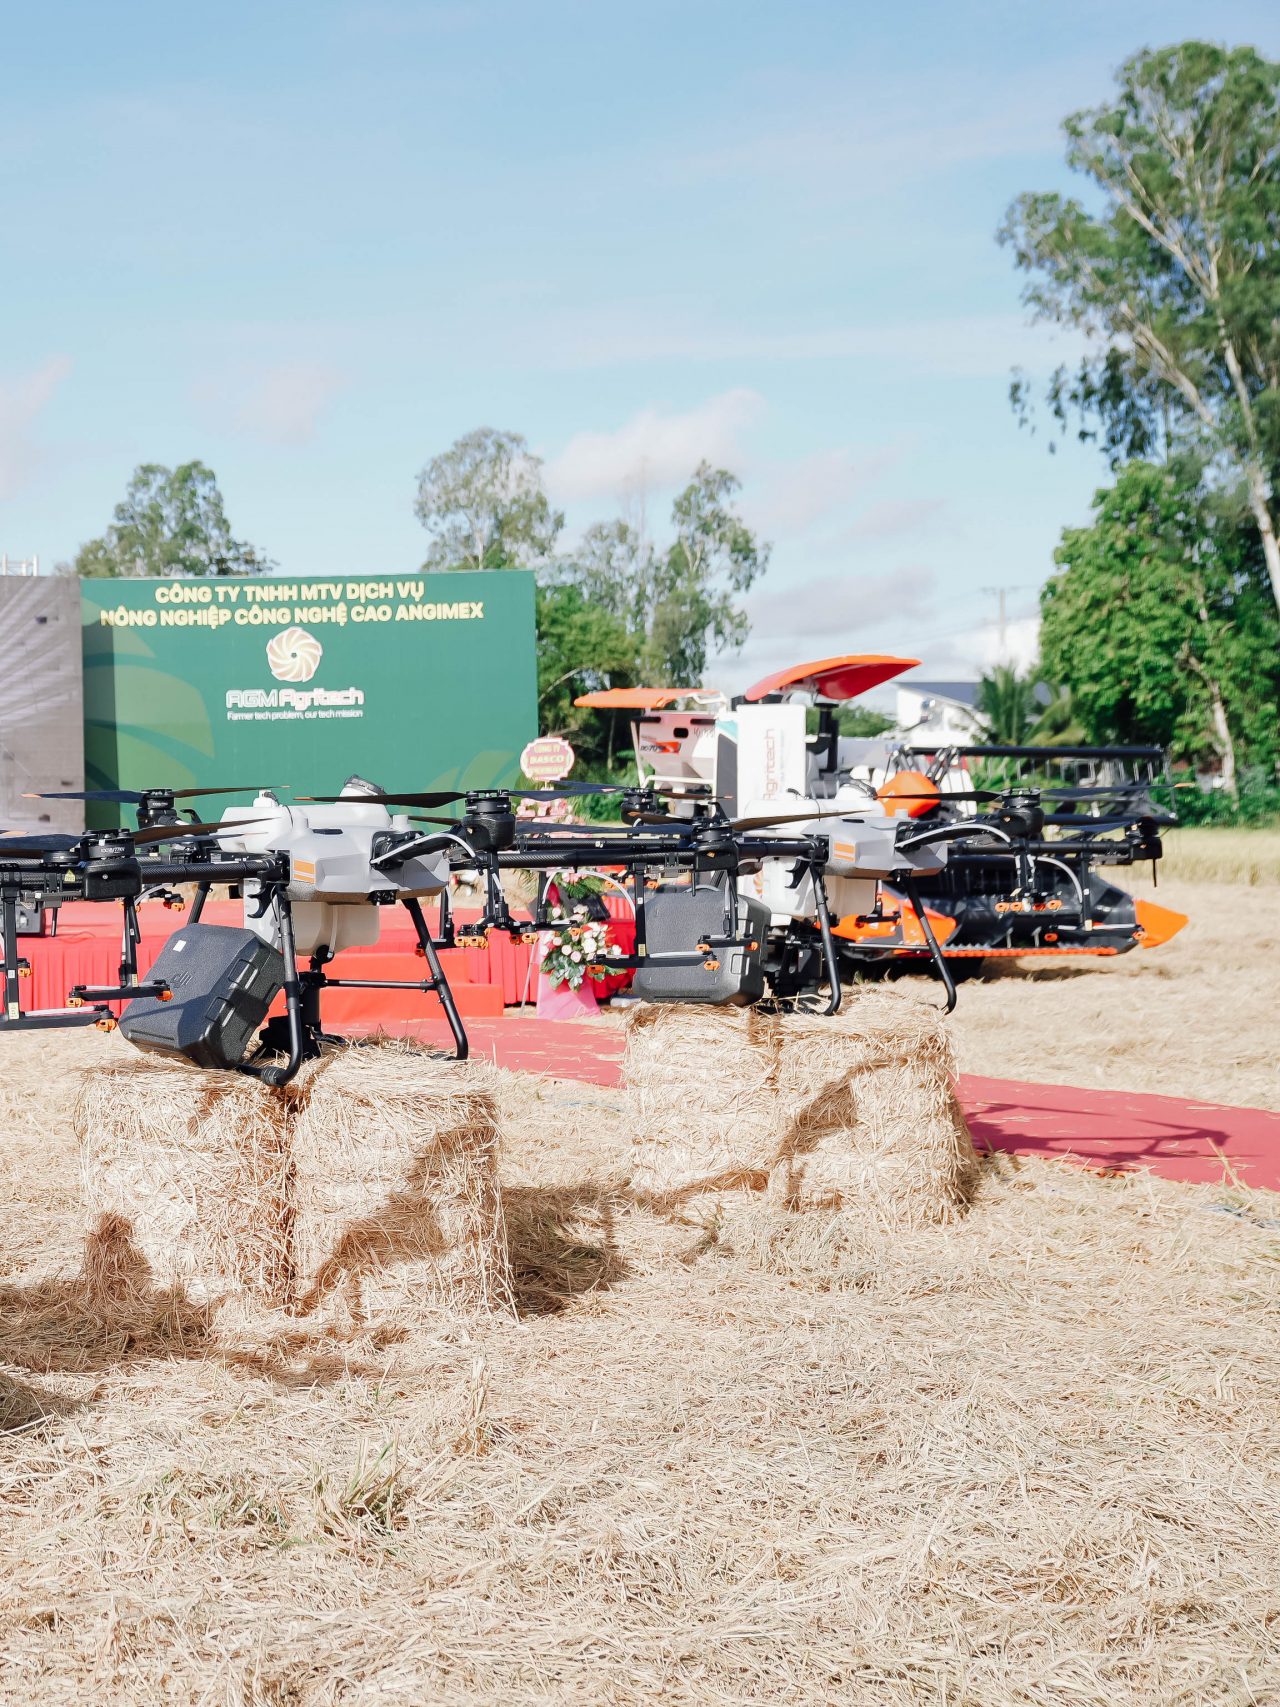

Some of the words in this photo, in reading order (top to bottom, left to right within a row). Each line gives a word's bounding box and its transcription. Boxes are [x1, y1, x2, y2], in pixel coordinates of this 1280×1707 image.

[155, 582, 213, 603] CÔNG
[215, 585, 241, 603] TY
[243, 584, 299, 602] TNHH
[300, 583, 344, 601] MTV
[346, 582, 395, 604] DỊCH
[396, 580, 425, 602] VỤ
[100, 604, 158, 627] NÔNG
[160, 604, 232, 630] NGHIỆP
[234, 603, 291, 625] CÔNG
[294, 602, 348, 627] NGHỆ
[350, 604, 393, 623] CAO
[395, 601, 485, 622] ANGIMEX
[225, 688, 278, 708] AGM
[278, 686, 365, 711] Agritech
